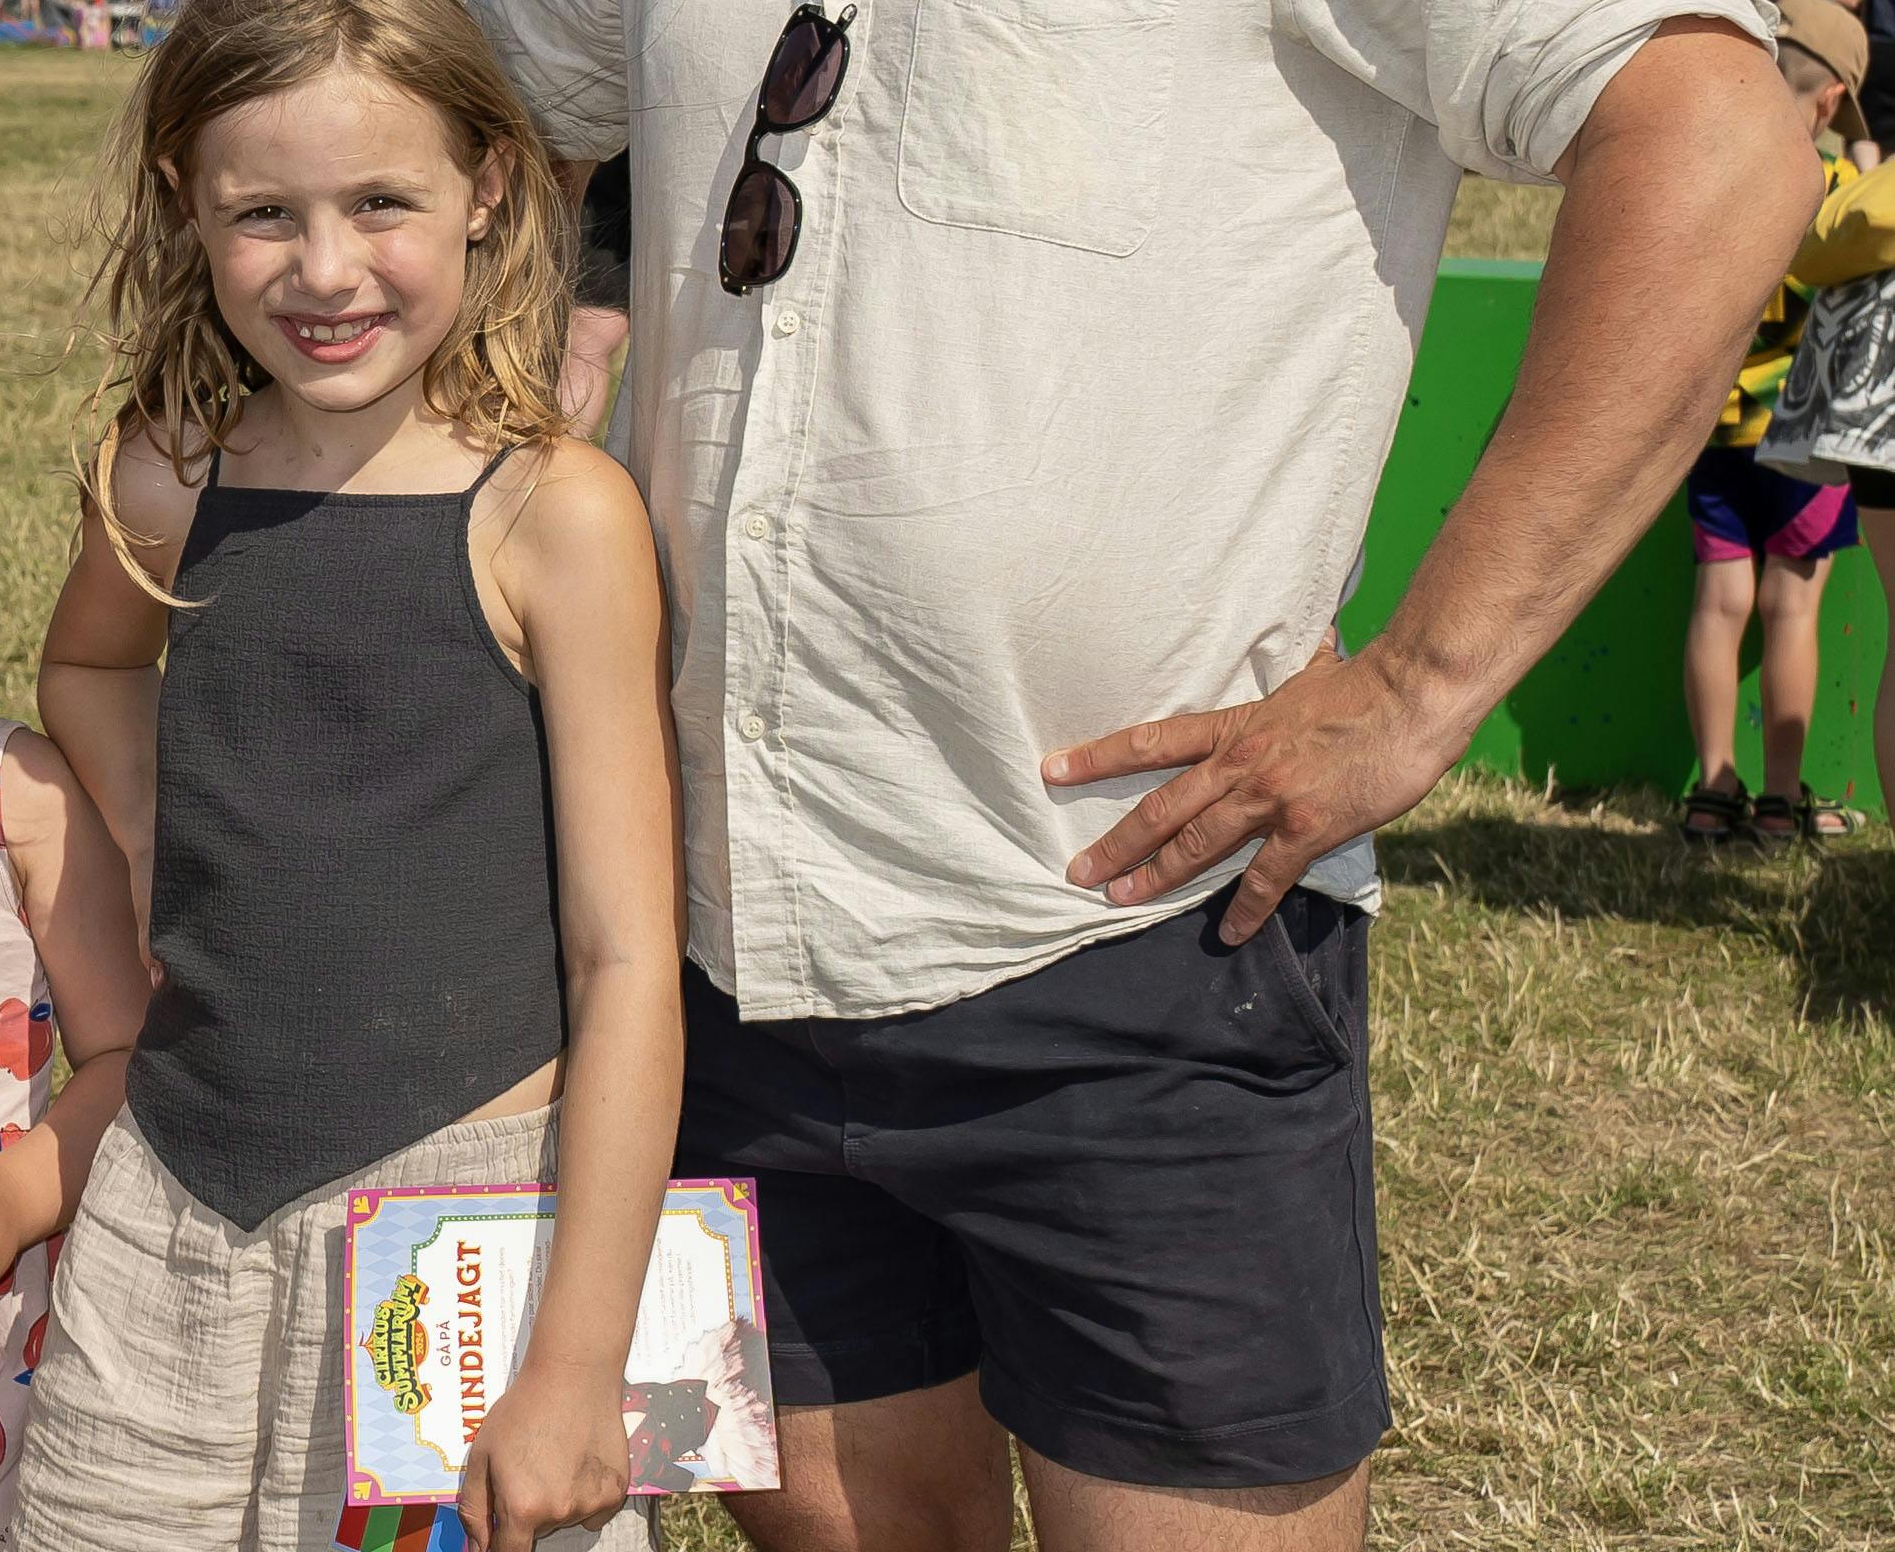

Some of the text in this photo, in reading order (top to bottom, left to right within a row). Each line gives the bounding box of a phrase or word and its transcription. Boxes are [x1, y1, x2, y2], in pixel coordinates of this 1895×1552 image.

[374, 1305, 391, 1386] CIRKUS
[392, 1275, 418, 1413] SUMMARUM
[415, 1332, 425, 1357] 2024
[436, 1320, 452, 1367] GÅ PÅ
[456, 1240, 486, 1445] MINDEJAGT
